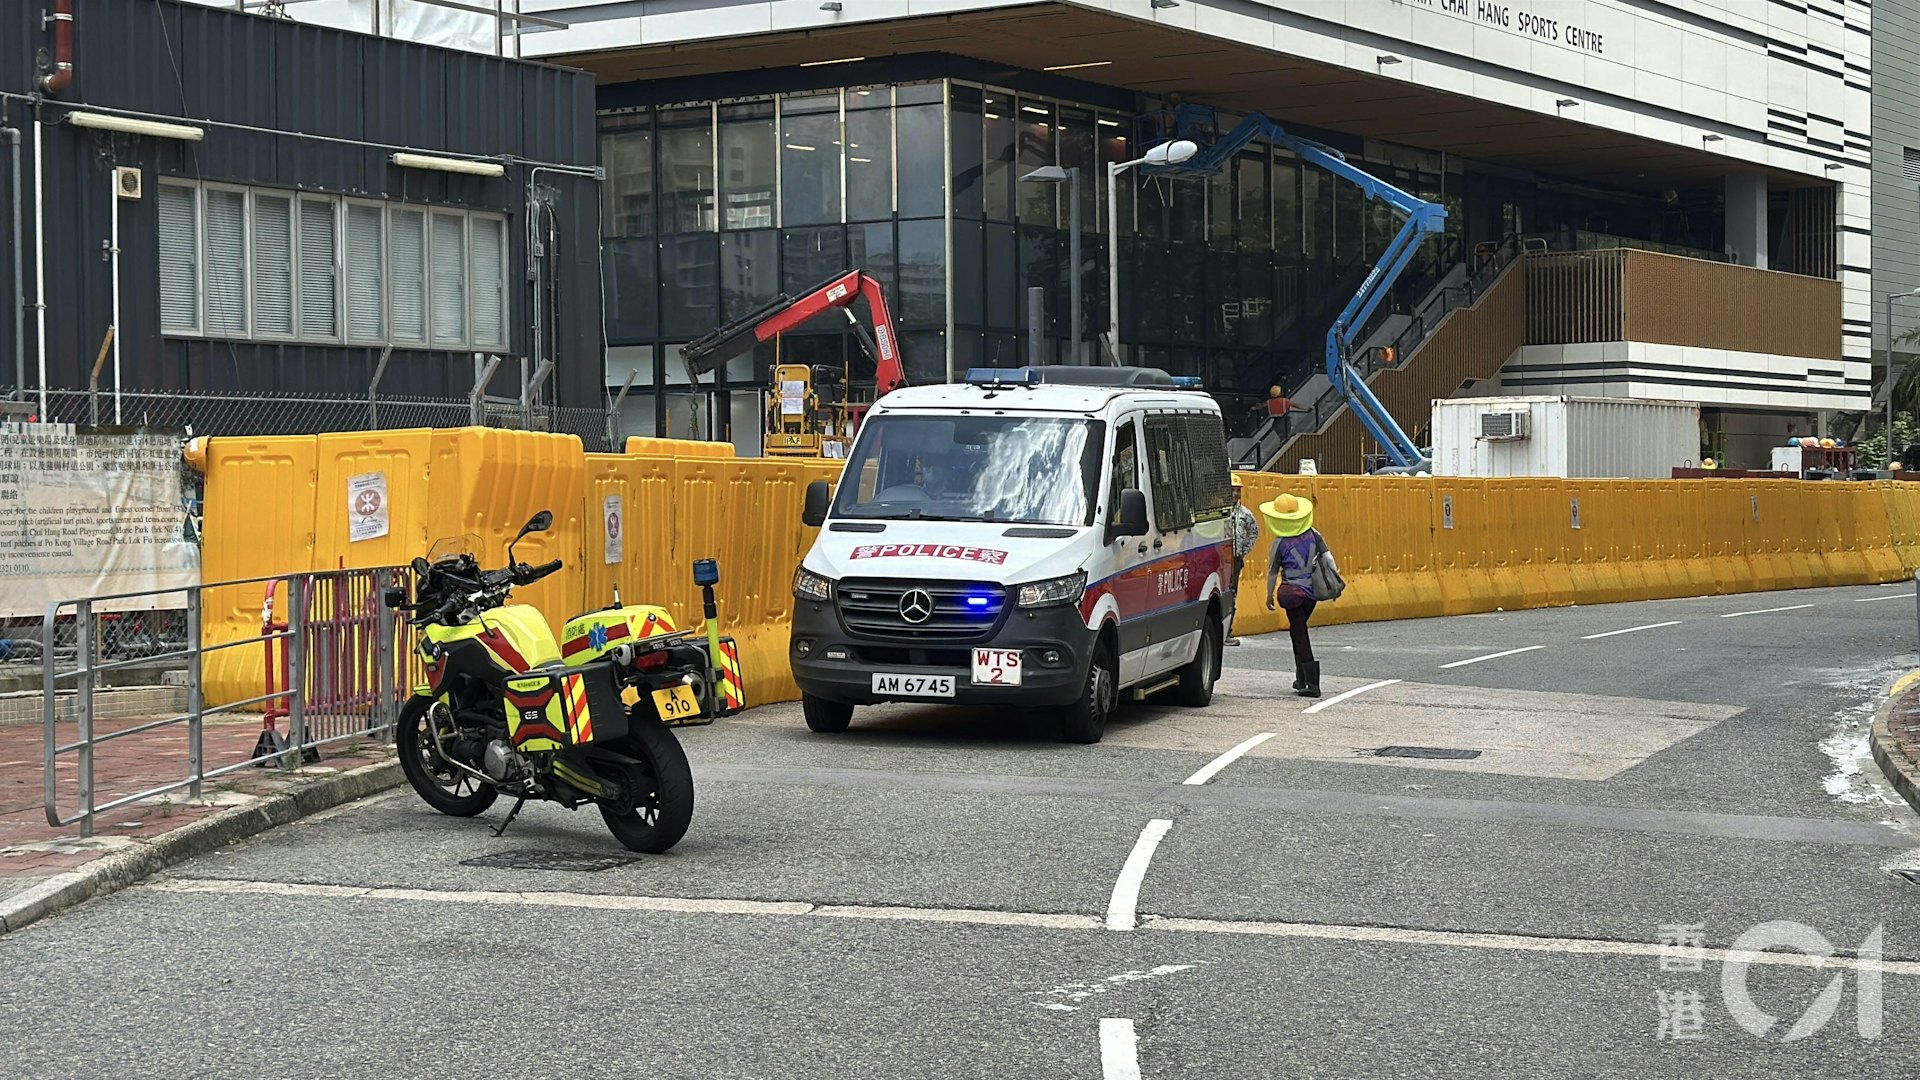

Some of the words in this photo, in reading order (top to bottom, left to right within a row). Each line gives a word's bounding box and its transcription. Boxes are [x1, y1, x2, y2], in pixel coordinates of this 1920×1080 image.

[1477, 1, 1509, 27] HANG
[1518, 11, 1558, 41] SPORTS
[1565, 25, 1603, 53] CENTRE
[39, 507, 63, 515] children
[66, 506, 99, 516] playground
[62, 527, 78, 536] Road
[134, 526, 149, 534] Park
[55, 539, 71, 548] Kong
[73, 538, 94, 547] Village
[878, 544, 980, 560] POLICE
[977, 650, 1018, 667] WTS
[990, 668, 1003, 684] 2
[877, 677, 899, 692] AM
[904, 678, 950, 693] 6745
[670, 689, 679, 702] A
[525, 710, 539, 720] GS
[665, 699, 691, 715] 910
